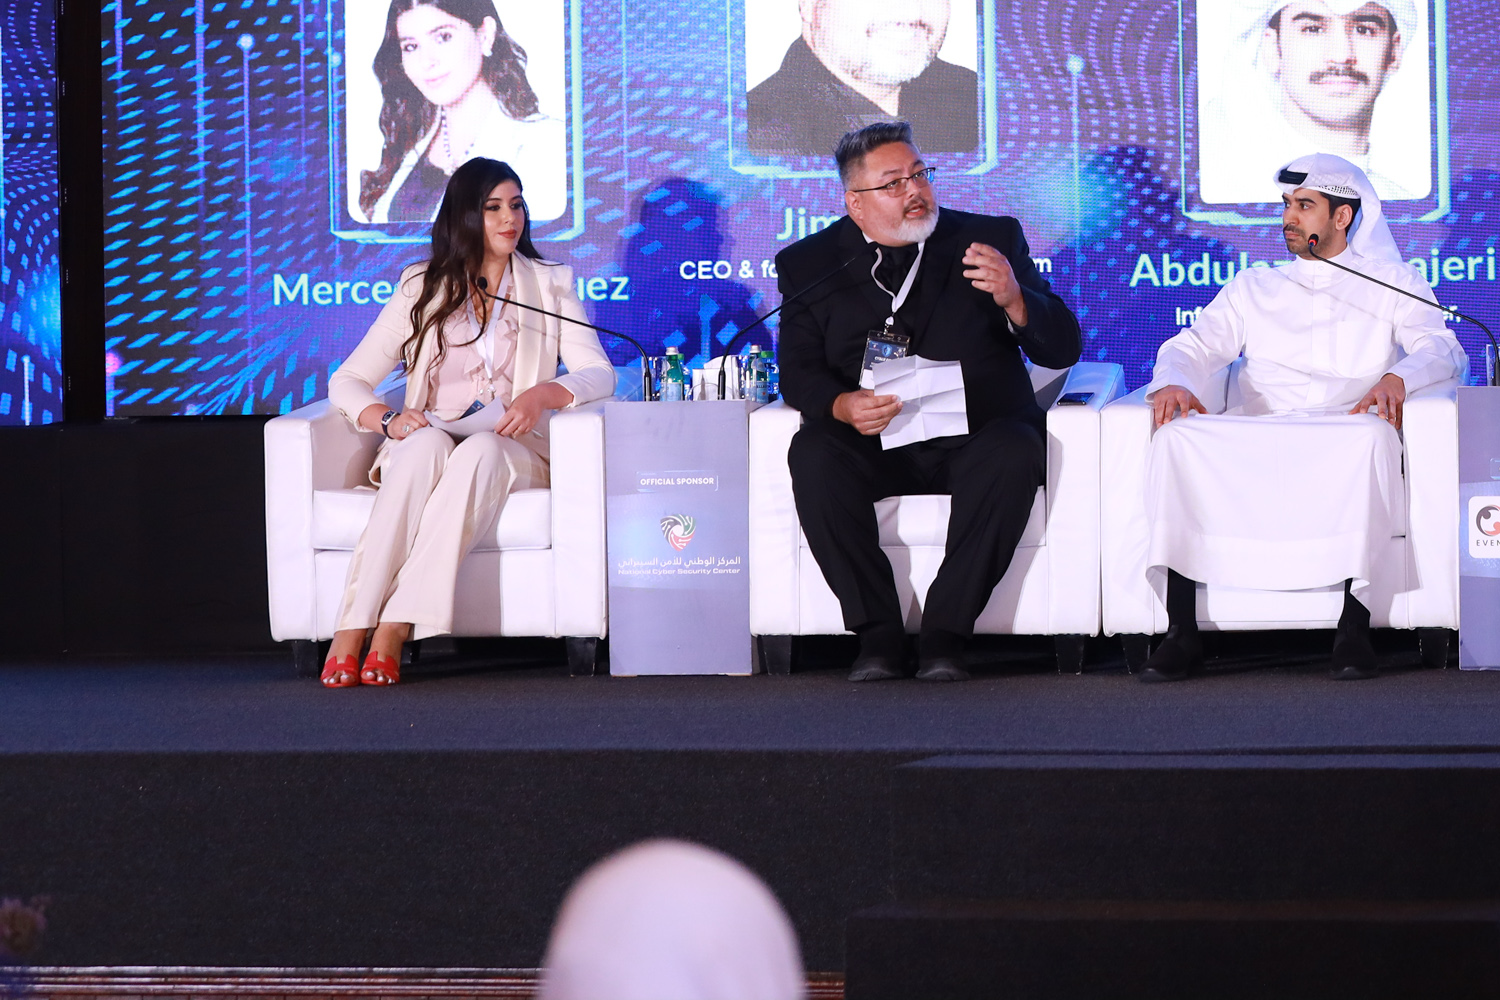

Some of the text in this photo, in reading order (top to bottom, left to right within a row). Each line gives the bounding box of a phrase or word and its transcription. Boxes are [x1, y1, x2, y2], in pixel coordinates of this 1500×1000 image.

[679, 260, 732, 280] CEO
[738, 260, 754, 279] &
[1129, 246, 1496, 289] Abdul ajeri
[273, 273, 398, 306] Merce
[640, 477, 714, 486] OFFICIAL SPONSOR
[684, 556, 715, 568] الوطني
[717, 556, 741, 567] المركز
[652, 568, 676, 576] Cyber
[677, 567, 711, 576] Security
